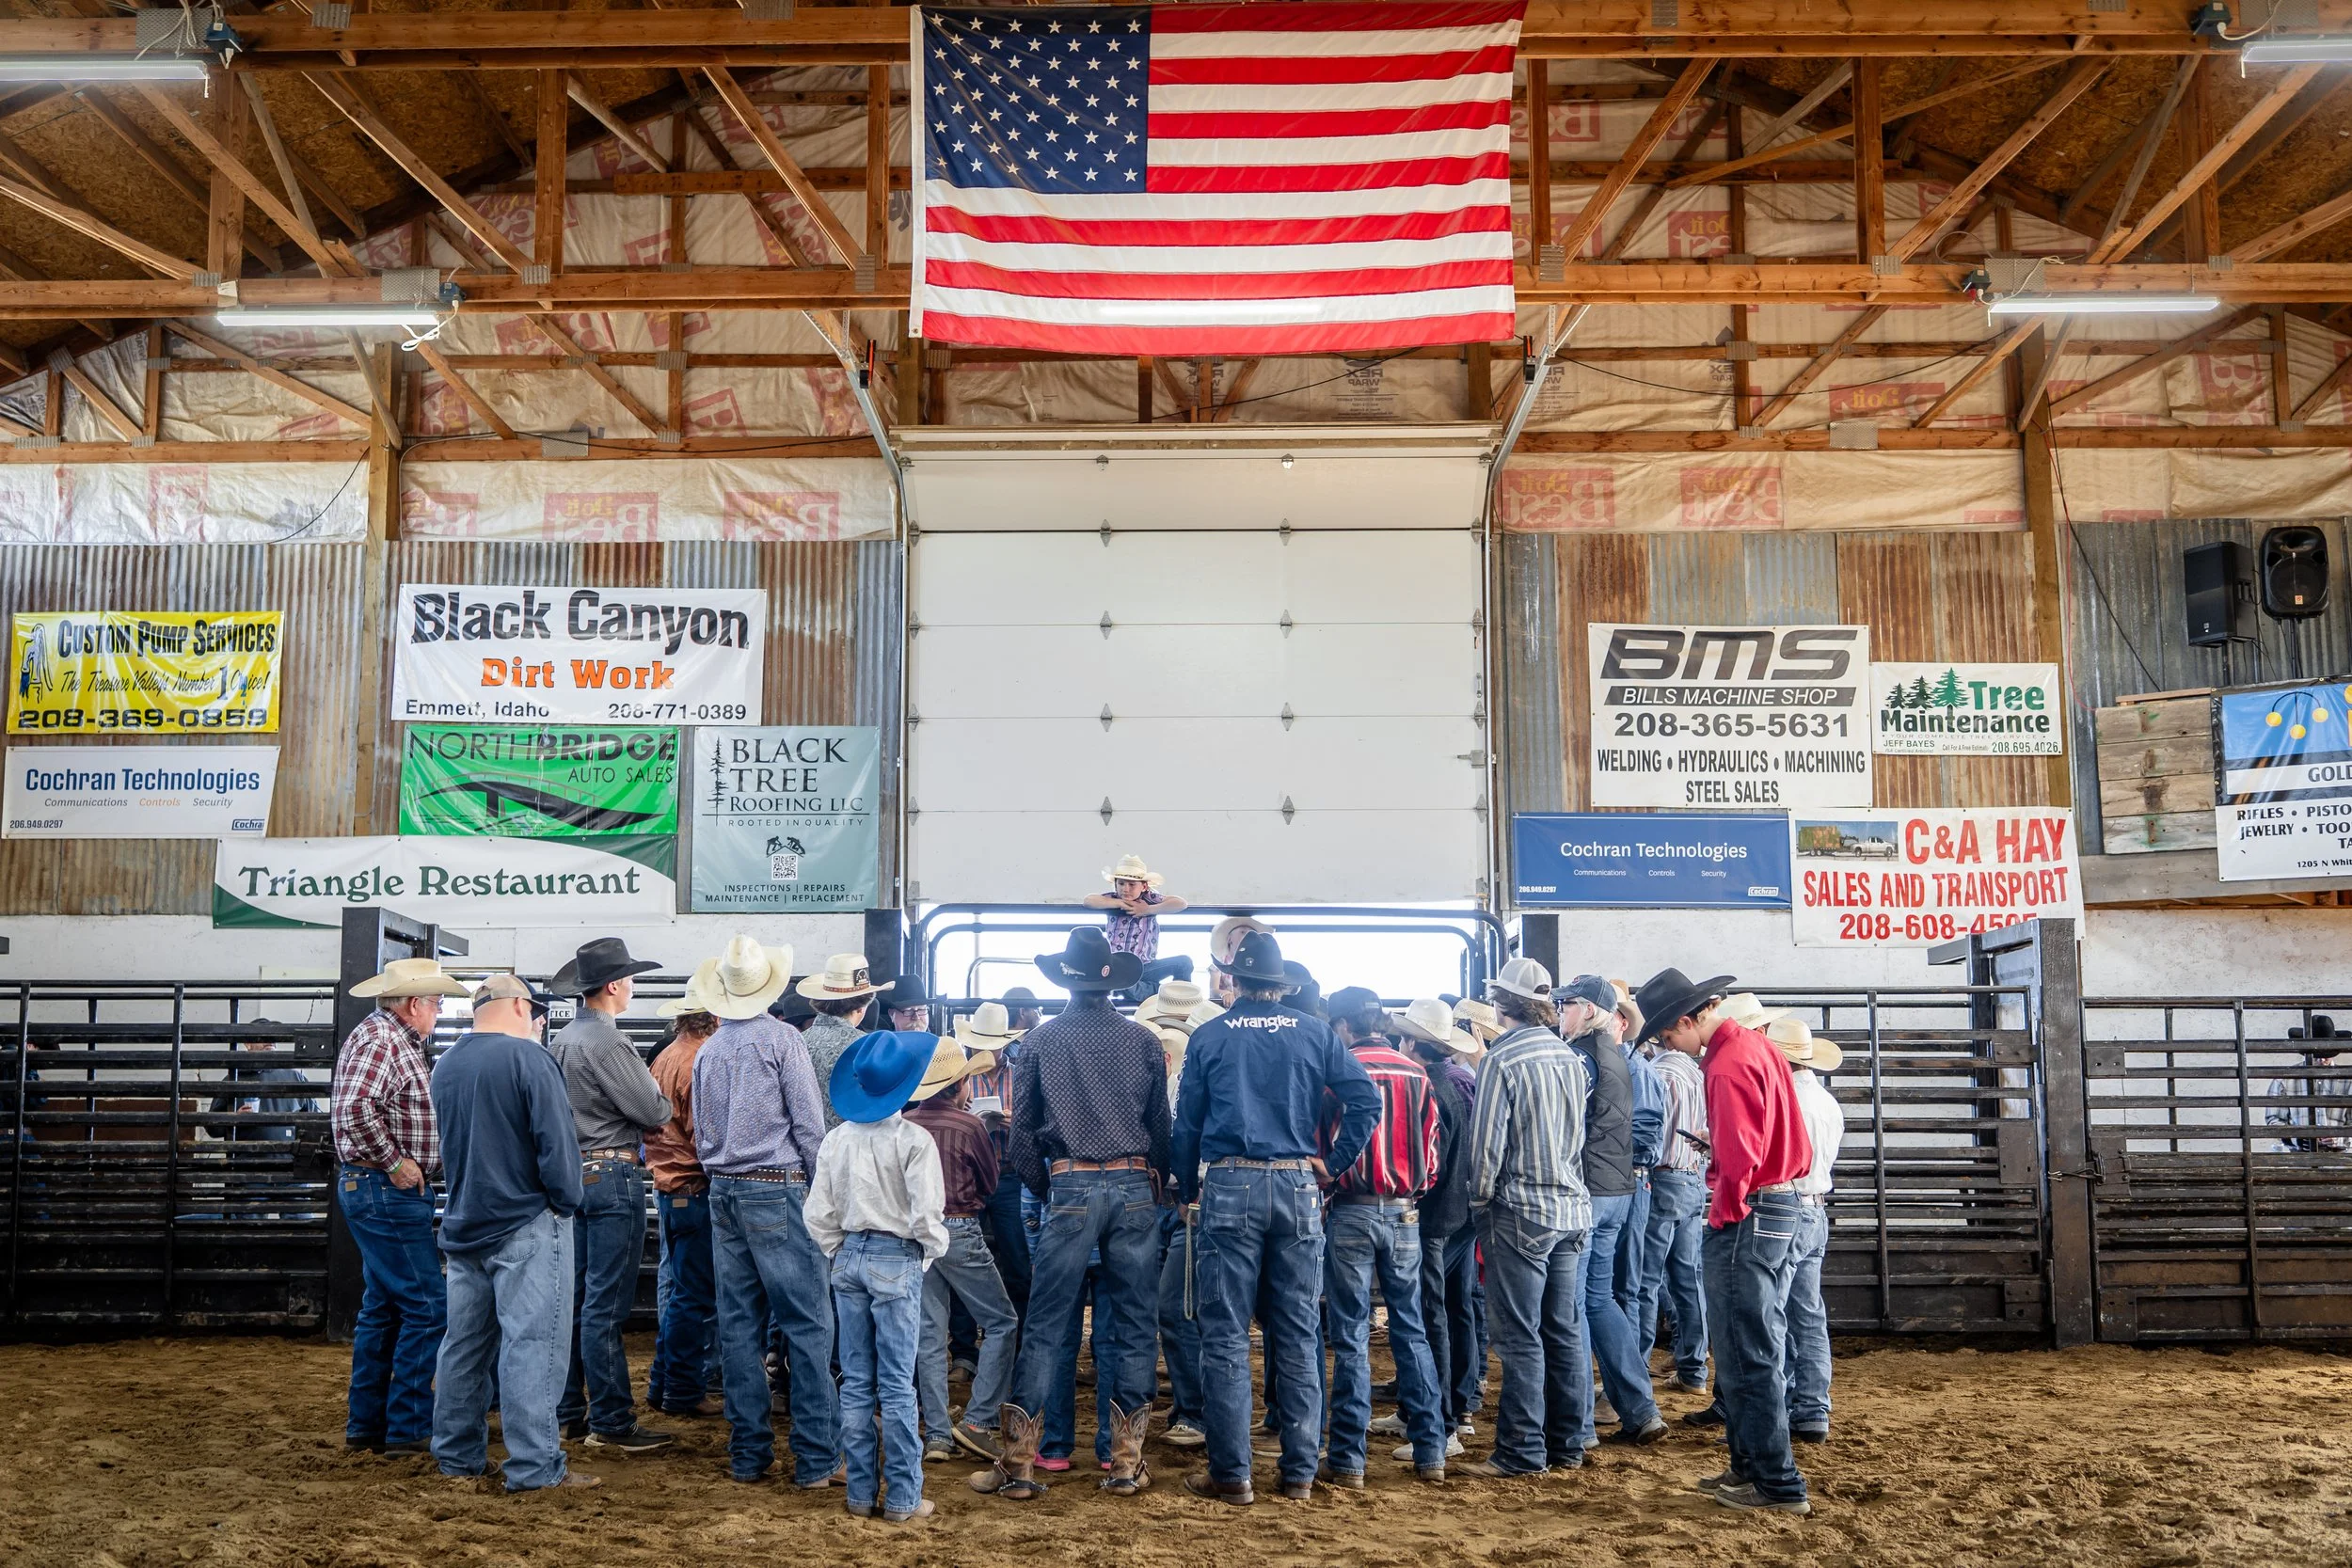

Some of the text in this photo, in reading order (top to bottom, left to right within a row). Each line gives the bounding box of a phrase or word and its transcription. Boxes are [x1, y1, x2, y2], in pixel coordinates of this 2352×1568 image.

[411, 589, 750, 656] Black Canyon
[1600, 628, 1858, 680] BMS
[61, 670, 81, 692] The
[87, 670, 130, 692] Treasure
[172, 670, 215, 692] Number
[216, 665, 229, 701] 1
[481, 657, 675, 689] Dirt Work
[1622, 688, 1838, 705] BILLS MACHINE SHOP
[1967, 681, 2045, 711] Tree
[18, 708, 268, 729] 208-369-0859
[405, 699, 550, 720] Emmett, Idaho
[608, 702, 747, 721] 208-771-0389
[1881, 705, 2050, 734] Maintenance
[1614, 712, 1848, 737] 208-365-5631
[409, 731, 676, 762] NORTHBRIDGE
[730, 737, 849, 764] BLACK
[1992, 741, 2058, 753] 208.695.4026
[1597, 749, 1865, 773] WELDING HYDRAULICS MACHINING
[25, 768, 260, 794] Cochran Technologies
[567, 767, 674, 784] AUTO SALES
[729, 768, 818, 793] TREE
[1686, 781, 1779, 803] STEEL SALES
[44, 797, 233, 810] Communications Controls Security
[730, 796, 863, 813] ROOFING LLC
[2236, 807, 2284, 821] RIFLES
[9, 819, 63, 830] 206.949.0297
[234, 820, 264, 829] Cochra
[804, 818, 864, 828] QUALITY
[2240, 824, 2294, 840] JEWELRY
[1905, 818, 2066, 864] C&A HAY
[1560, 842, 1748, 863] Cochran Technologies
[1573, 868, 1627, 878] Communications
[1701, 869, 1727, 879] Security
[2296, 860, 2318, 868] 1205
[238, 865, 641, 903] Triangle Restaurant
[724, 884, 791, 893] INSPECTIONS
[1749, 887, 1778, 896] Cochran
[1804, 866, 2069, 908] SALES AND TRANSPORT
[705, 895, 865, 903] MAINTENANCE REPLACEMENT
[1224, 1015, 1298, 1033] Wrangler
